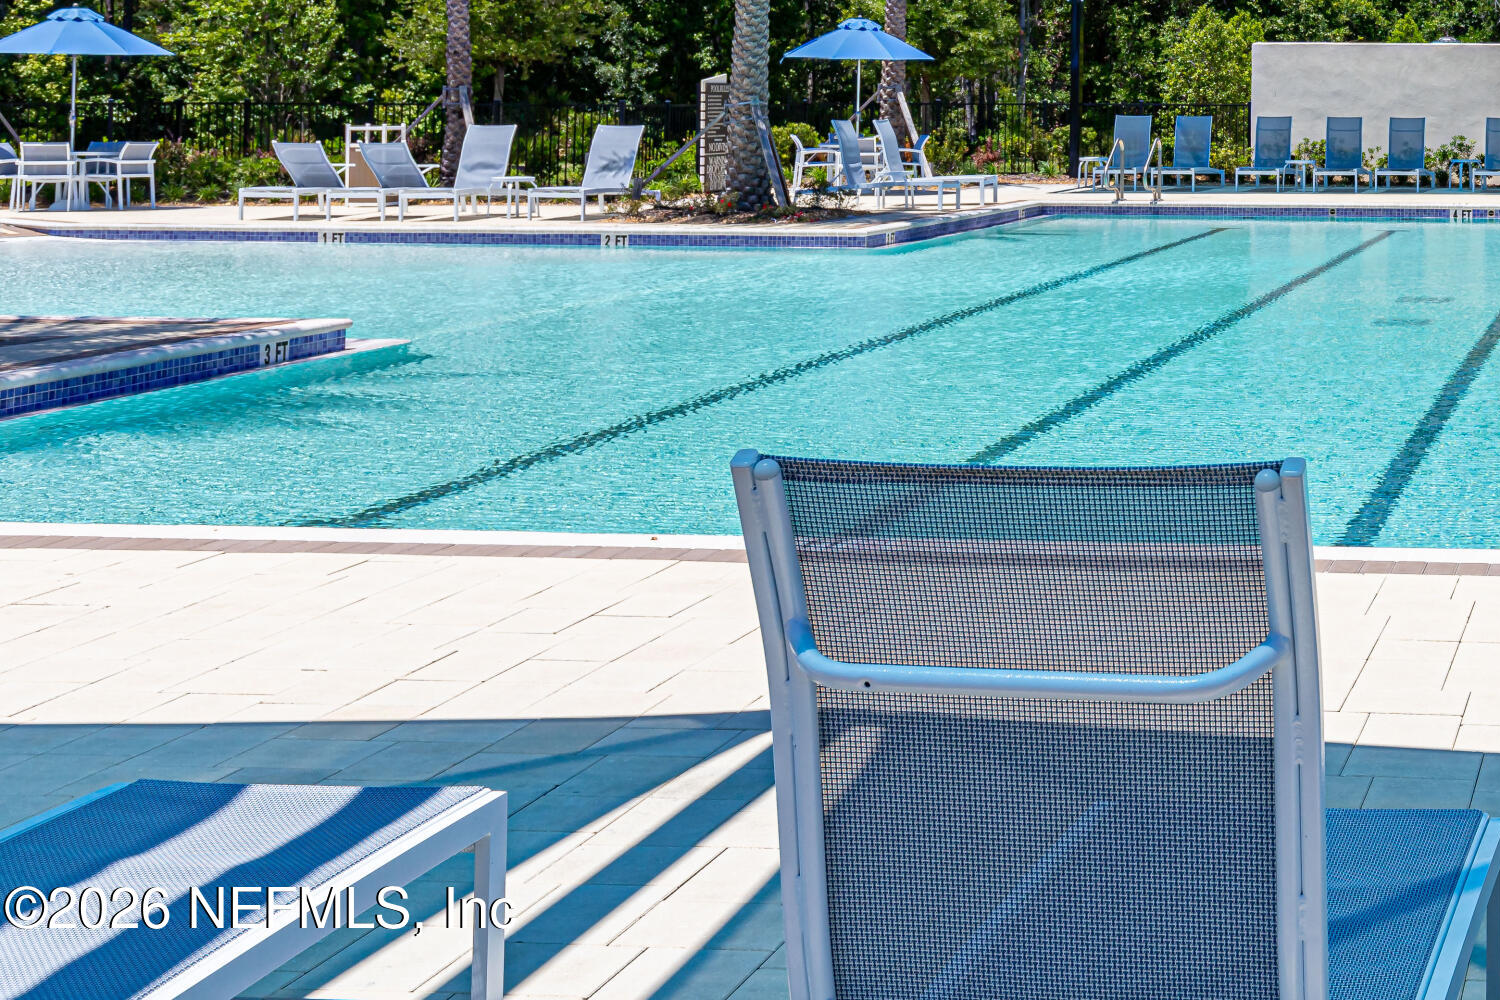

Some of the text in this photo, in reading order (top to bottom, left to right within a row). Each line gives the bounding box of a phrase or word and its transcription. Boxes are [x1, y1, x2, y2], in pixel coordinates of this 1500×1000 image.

[1461, 209, 1472, 222] FT
[322, 232, 344, 244] 1 FT
[604, 234, 628, 247] 2 FT
[263, 340, 289, 364] 3 FT
